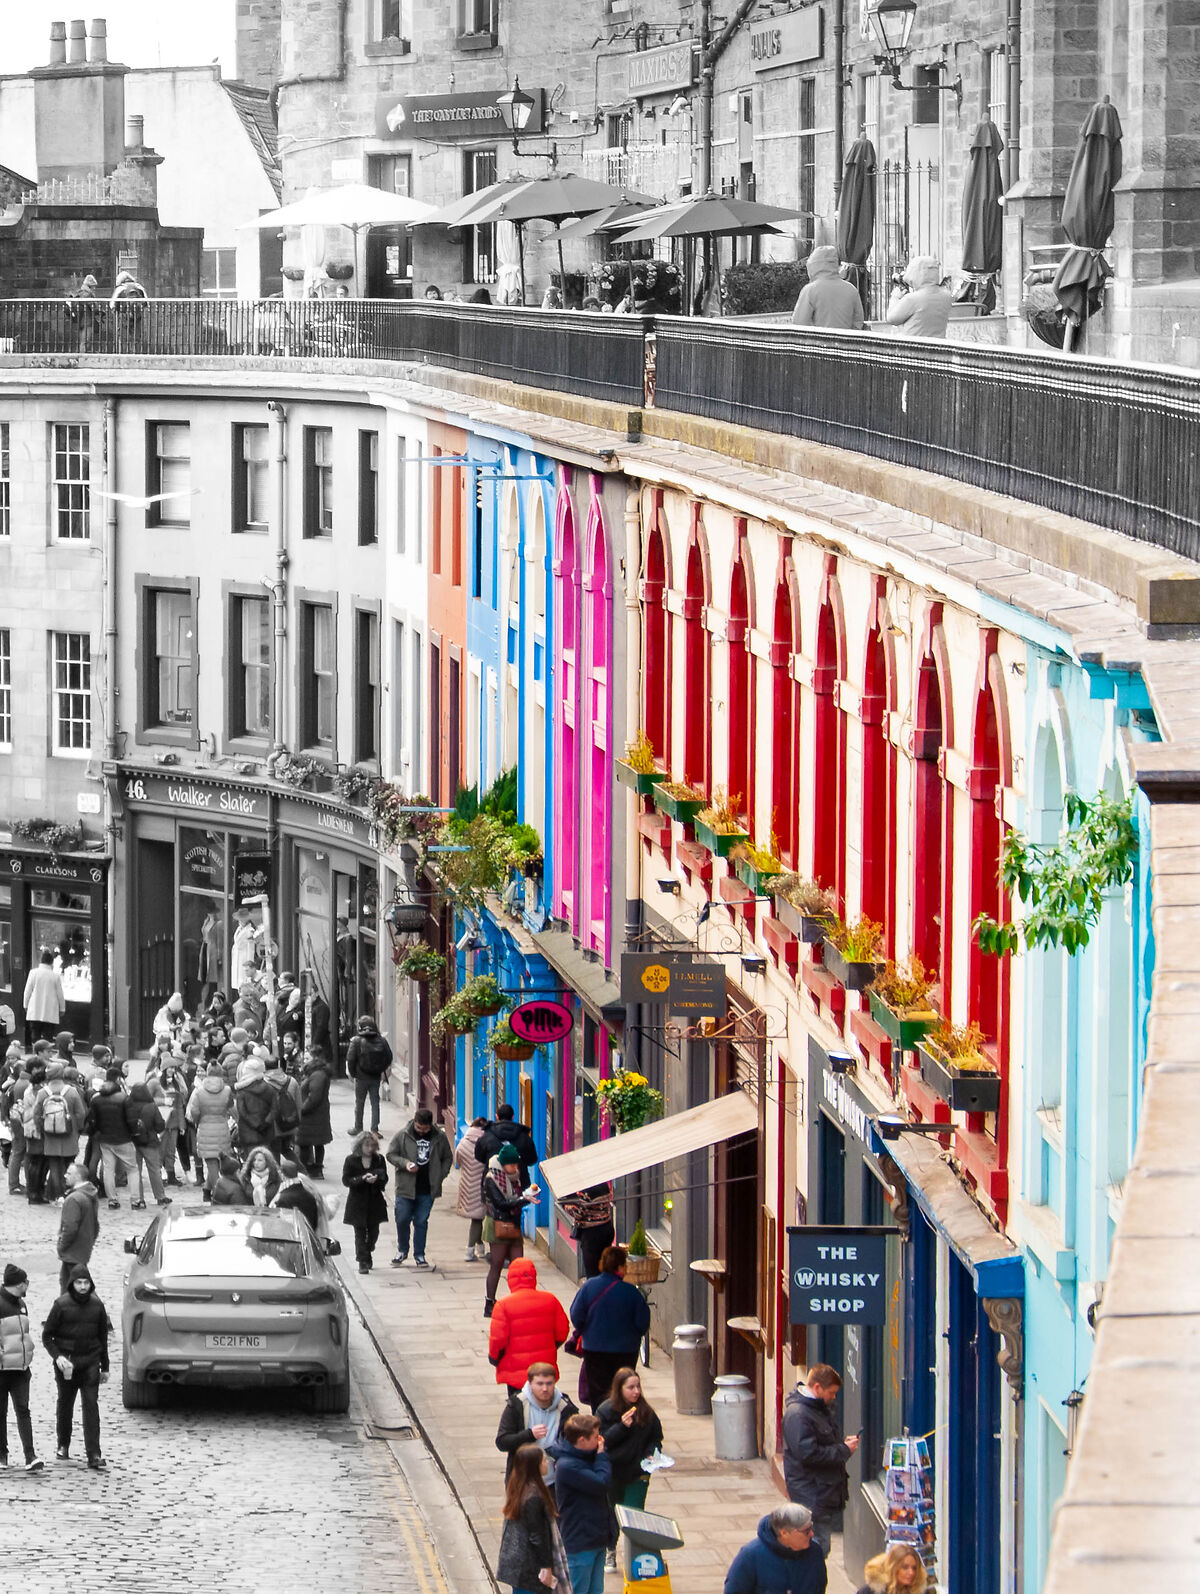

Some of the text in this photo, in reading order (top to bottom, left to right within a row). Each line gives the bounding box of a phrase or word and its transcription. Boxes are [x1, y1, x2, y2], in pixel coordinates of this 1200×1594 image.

[630, 54, 678, 88] MAXIES
[412, 110, 433, 123] THE
[434, 107, 471, 122] CASTLE
[168, 786, 212, 806] Walker
[220, 791, 256, 813] Slater
[317, 812, 354, 835] LADIESWEAR
[35, 866, 77, 877] CLARKSONS
[817, 1247, 857, 1260] THE
[794, 1270, 880, 1288] WHISKY
[809, 1298, 865, 1312] SHOP
[212, 1335, 260, 1347] SC21 FNG
